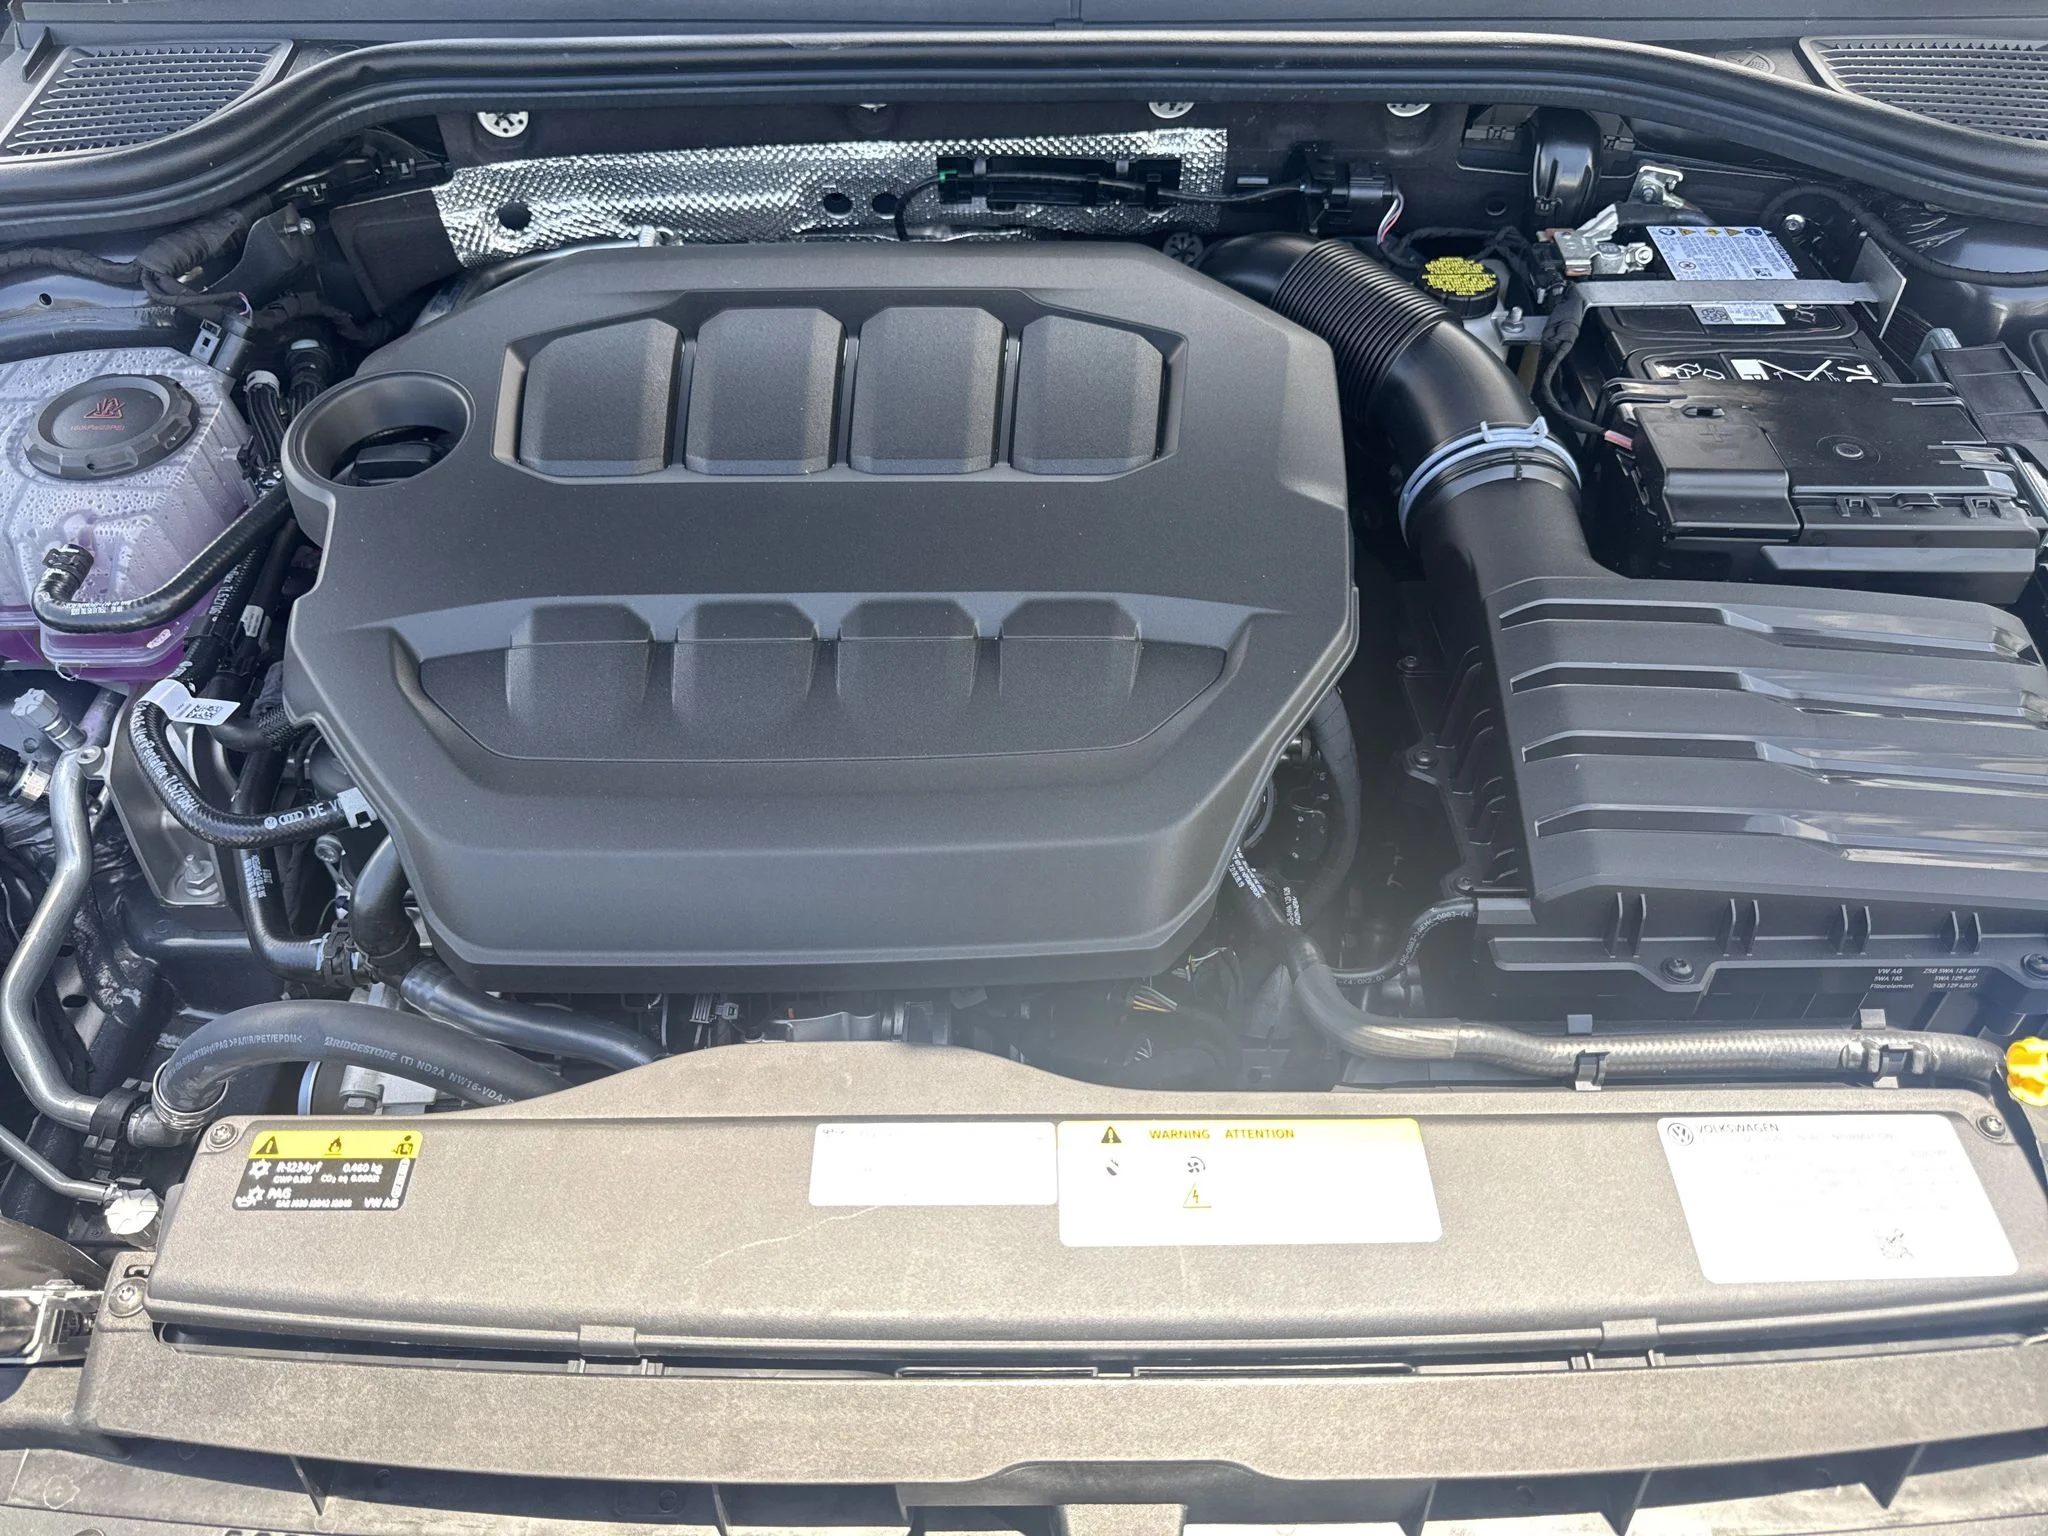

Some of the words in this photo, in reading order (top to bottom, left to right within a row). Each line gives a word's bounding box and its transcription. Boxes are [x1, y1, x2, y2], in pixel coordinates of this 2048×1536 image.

[308, 802, 328, 820] DE
[323, 1035, 398, 1061] BRIDGESTONE
[399, 1054, 414, 1067] (T)
[416, 1060, 445, 1079] ND2A
[1149, 1129, 1211, 1140] WARNING
[1225, 1128, 1295, 1140] ATTENTION
[1697, 1122, 1780, 1134] VOLKSWAGEN
[267, 1187, 293, 1200] PAG
[363, 1197, 382, 1209] VW
